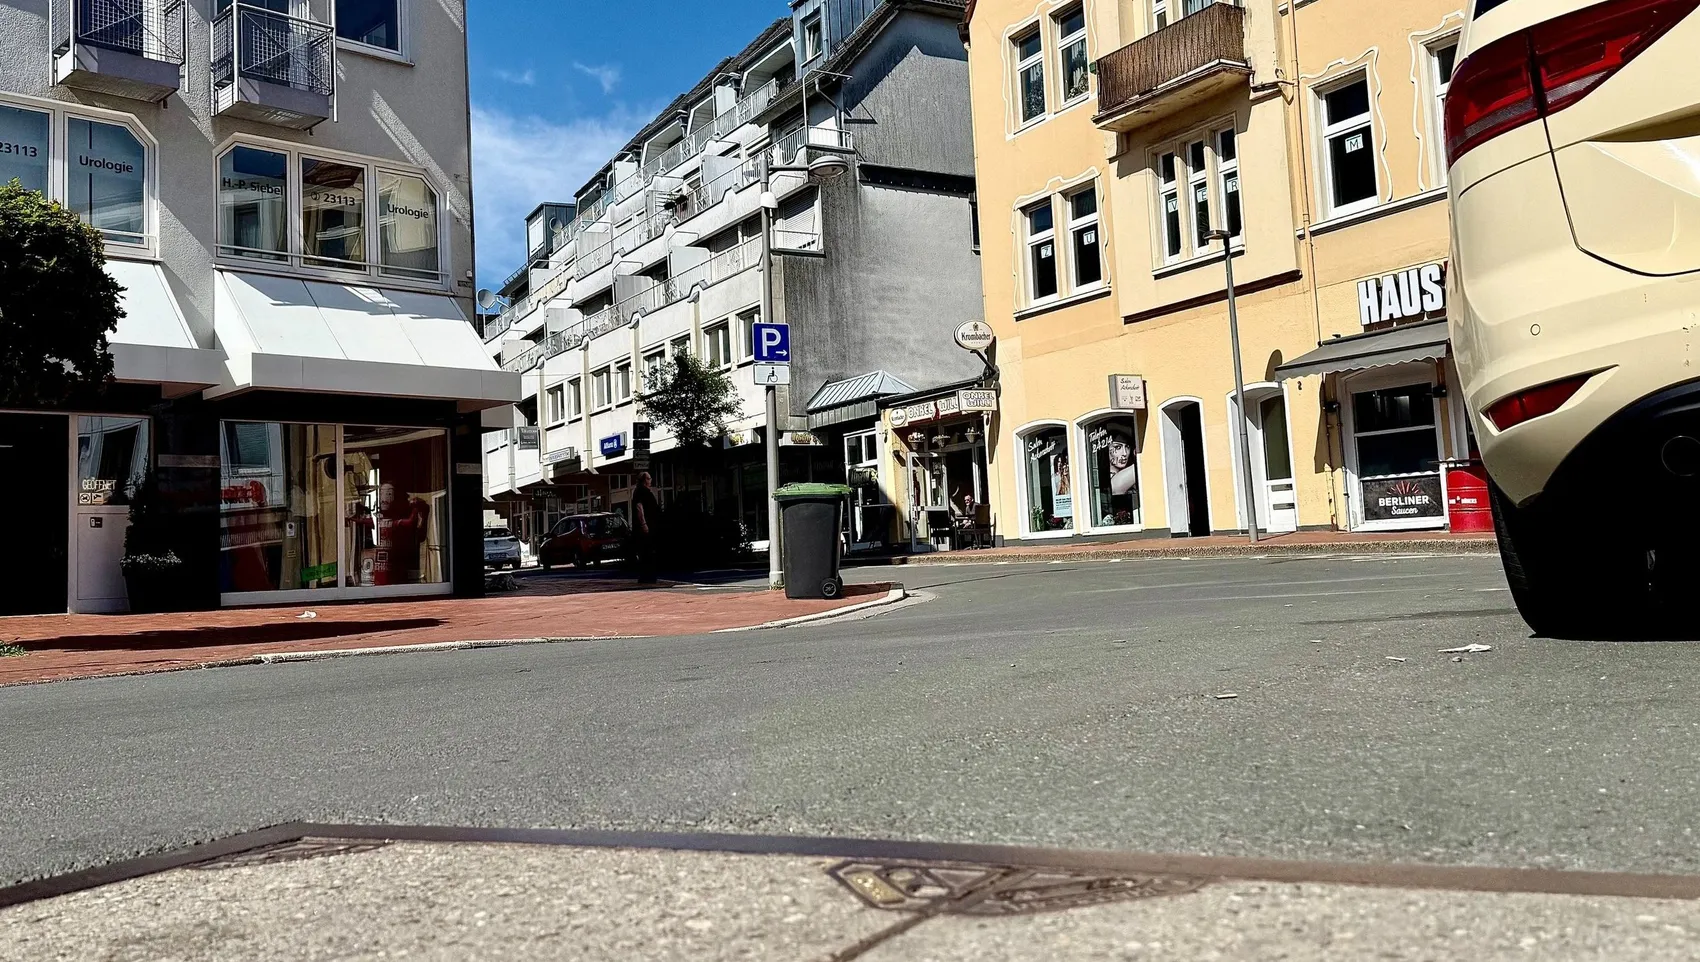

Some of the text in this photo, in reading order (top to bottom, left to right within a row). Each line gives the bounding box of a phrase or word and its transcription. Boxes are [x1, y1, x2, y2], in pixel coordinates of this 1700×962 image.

[0, 141, 38, 157] 23113
[1350, 139, 1359, 151] M
[79, 155, 134, 173] Urologie
[222, 177, 284, 196] H.-P. Siebel
[323, 193, 356, 206] 23113
[387, 203, 429, 220] Urologie
[1357, 263, 1444, 326] HAUS
[761, 328, 782, 357] P
[961, 331, 991, 342] Krombacher
[962, 391, 995, 401] ONKEL
[908, 403, 934, 419] ONKEL
[938, 396, 959, 413] WILL
[966, 399, 993, 408] WILLI
[1028, 437, 1043, 452] Salon
[82, 477, 117, 491] GEÖFFNET
[1378, 495, 1430, 507] BERLINER
[1391, 504, 1419, 516] Saucen
